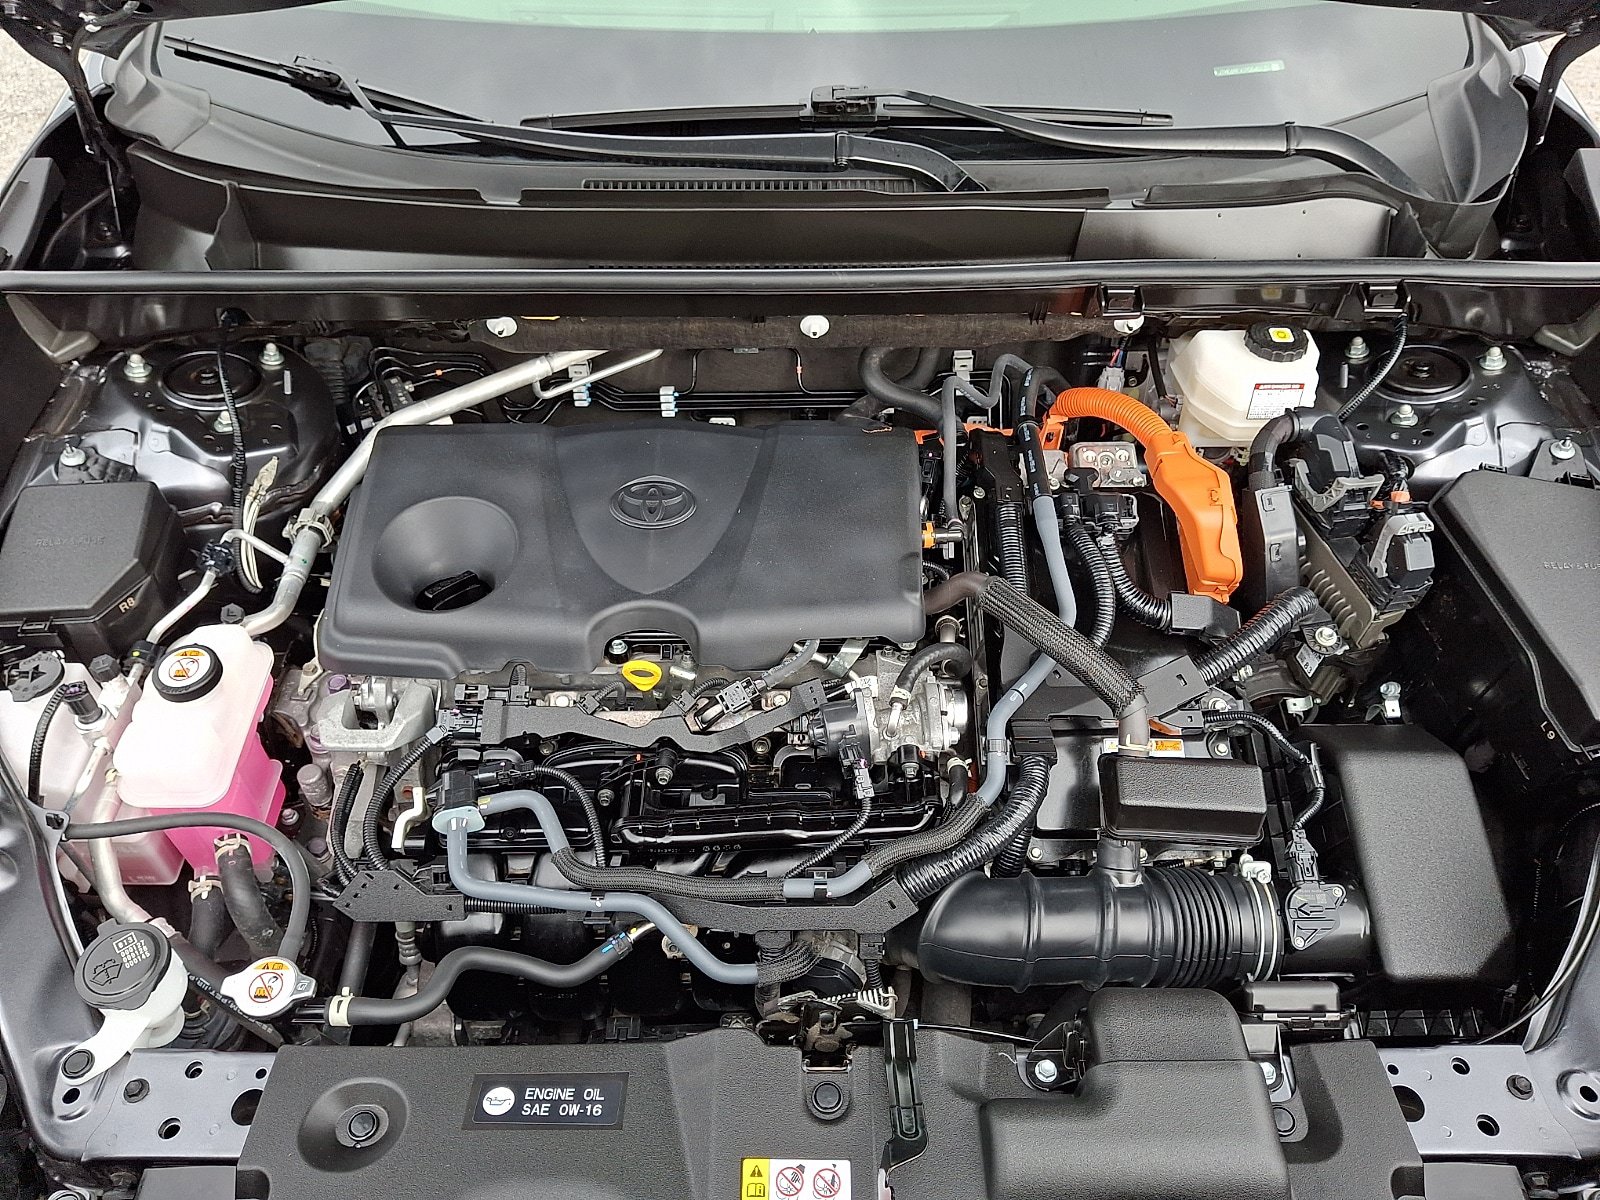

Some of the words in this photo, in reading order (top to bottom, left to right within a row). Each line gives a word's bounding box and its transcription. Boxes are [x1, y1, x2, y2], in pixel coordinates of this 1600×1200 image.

[118, 596, 136, 613] R8
[524, 1087, 576, 1101] ENGINE
[583, 1088, 605, 1101] OIL
[521, 1103, 550, 1116] SAE
[558, 1103, 603, 1117] 0W-16
